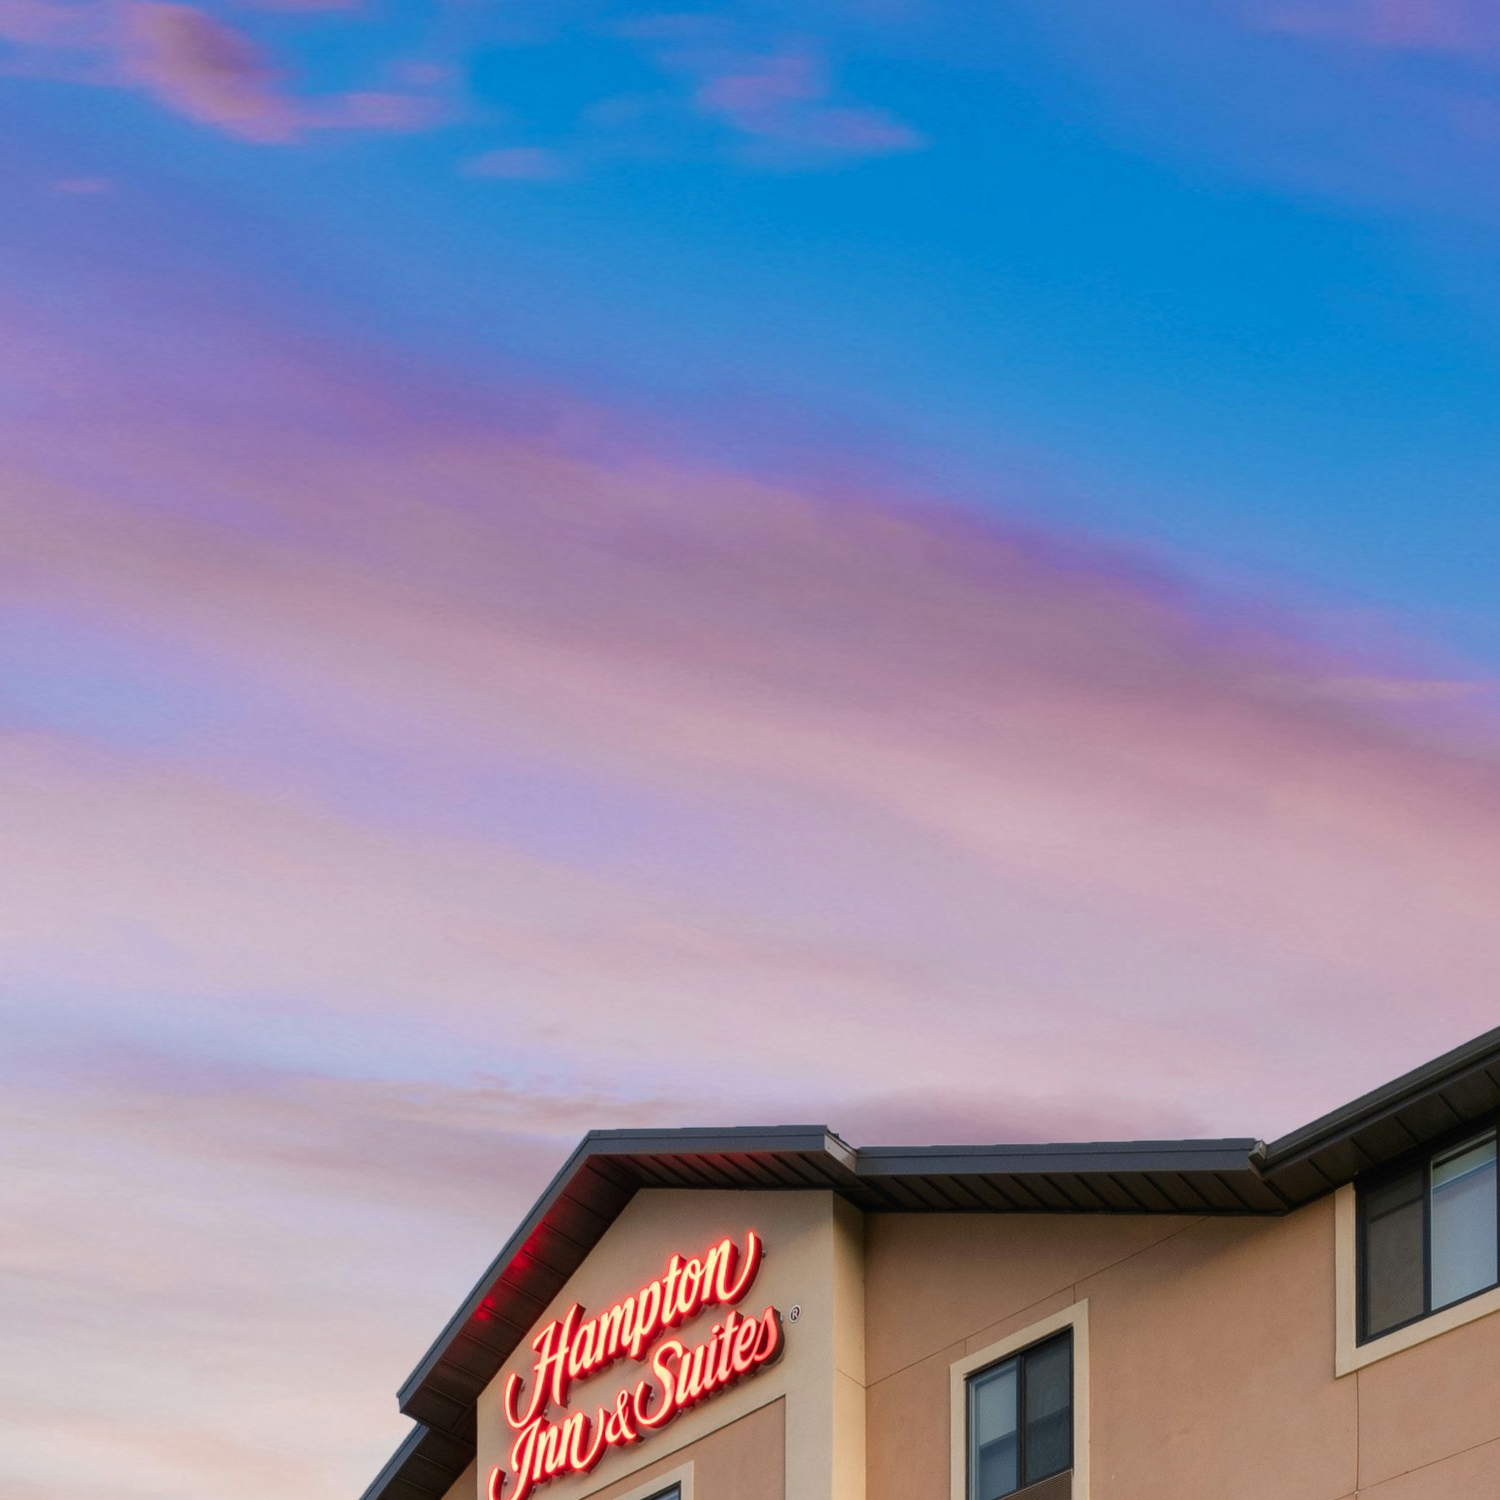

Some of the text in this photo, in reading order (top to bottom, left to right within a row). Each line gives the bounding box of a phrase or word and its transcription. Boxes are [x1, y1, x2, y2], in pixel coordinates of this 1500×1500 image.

[504, 1231, 763, 1429] Hampton
[605, 1389, 645, 1445] &
[633, 1305, 785, 1429] Suites
